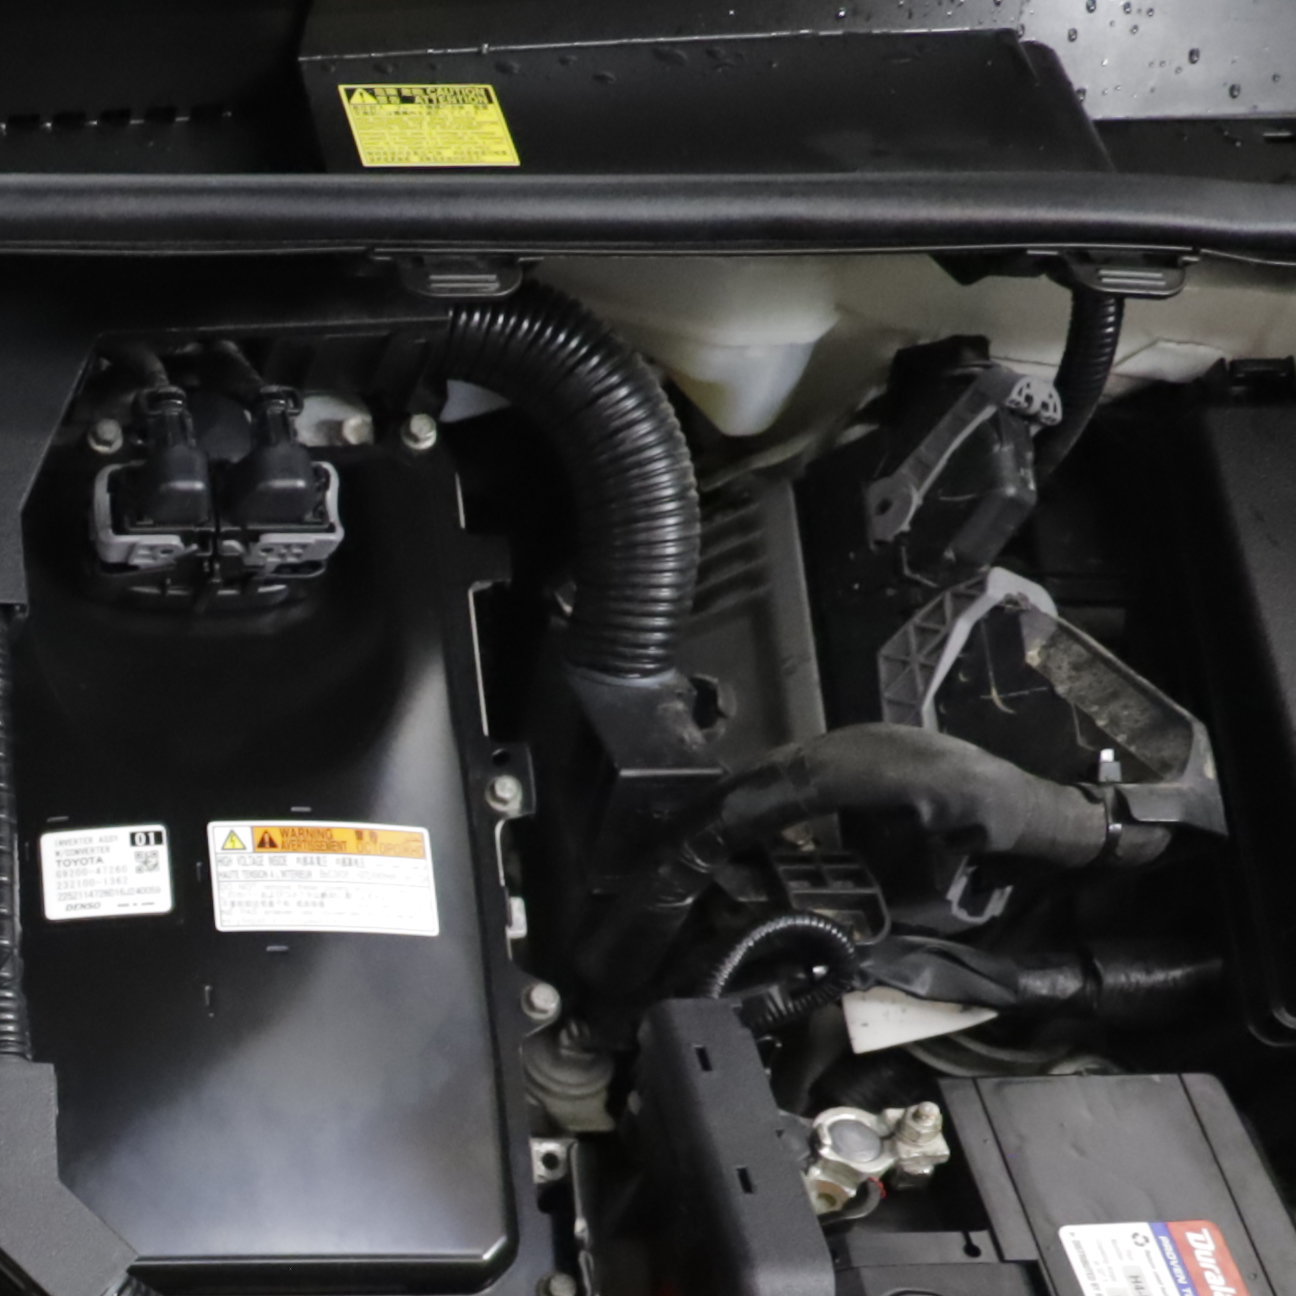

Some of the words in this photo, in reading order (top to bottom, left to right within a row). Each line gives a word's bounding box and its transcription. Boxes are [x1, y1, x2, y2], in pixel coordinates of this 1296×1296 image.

[426, 88, 486, 96] CAUTION
[135, 832, 156, 846] 01
[281, 828, 334, 840] WARNING
[56, 857, 104, 867] TOYOTA
[65, 902, 101, 911] DENSO
[1158, 1235, 1187, 1285] PROVEN
